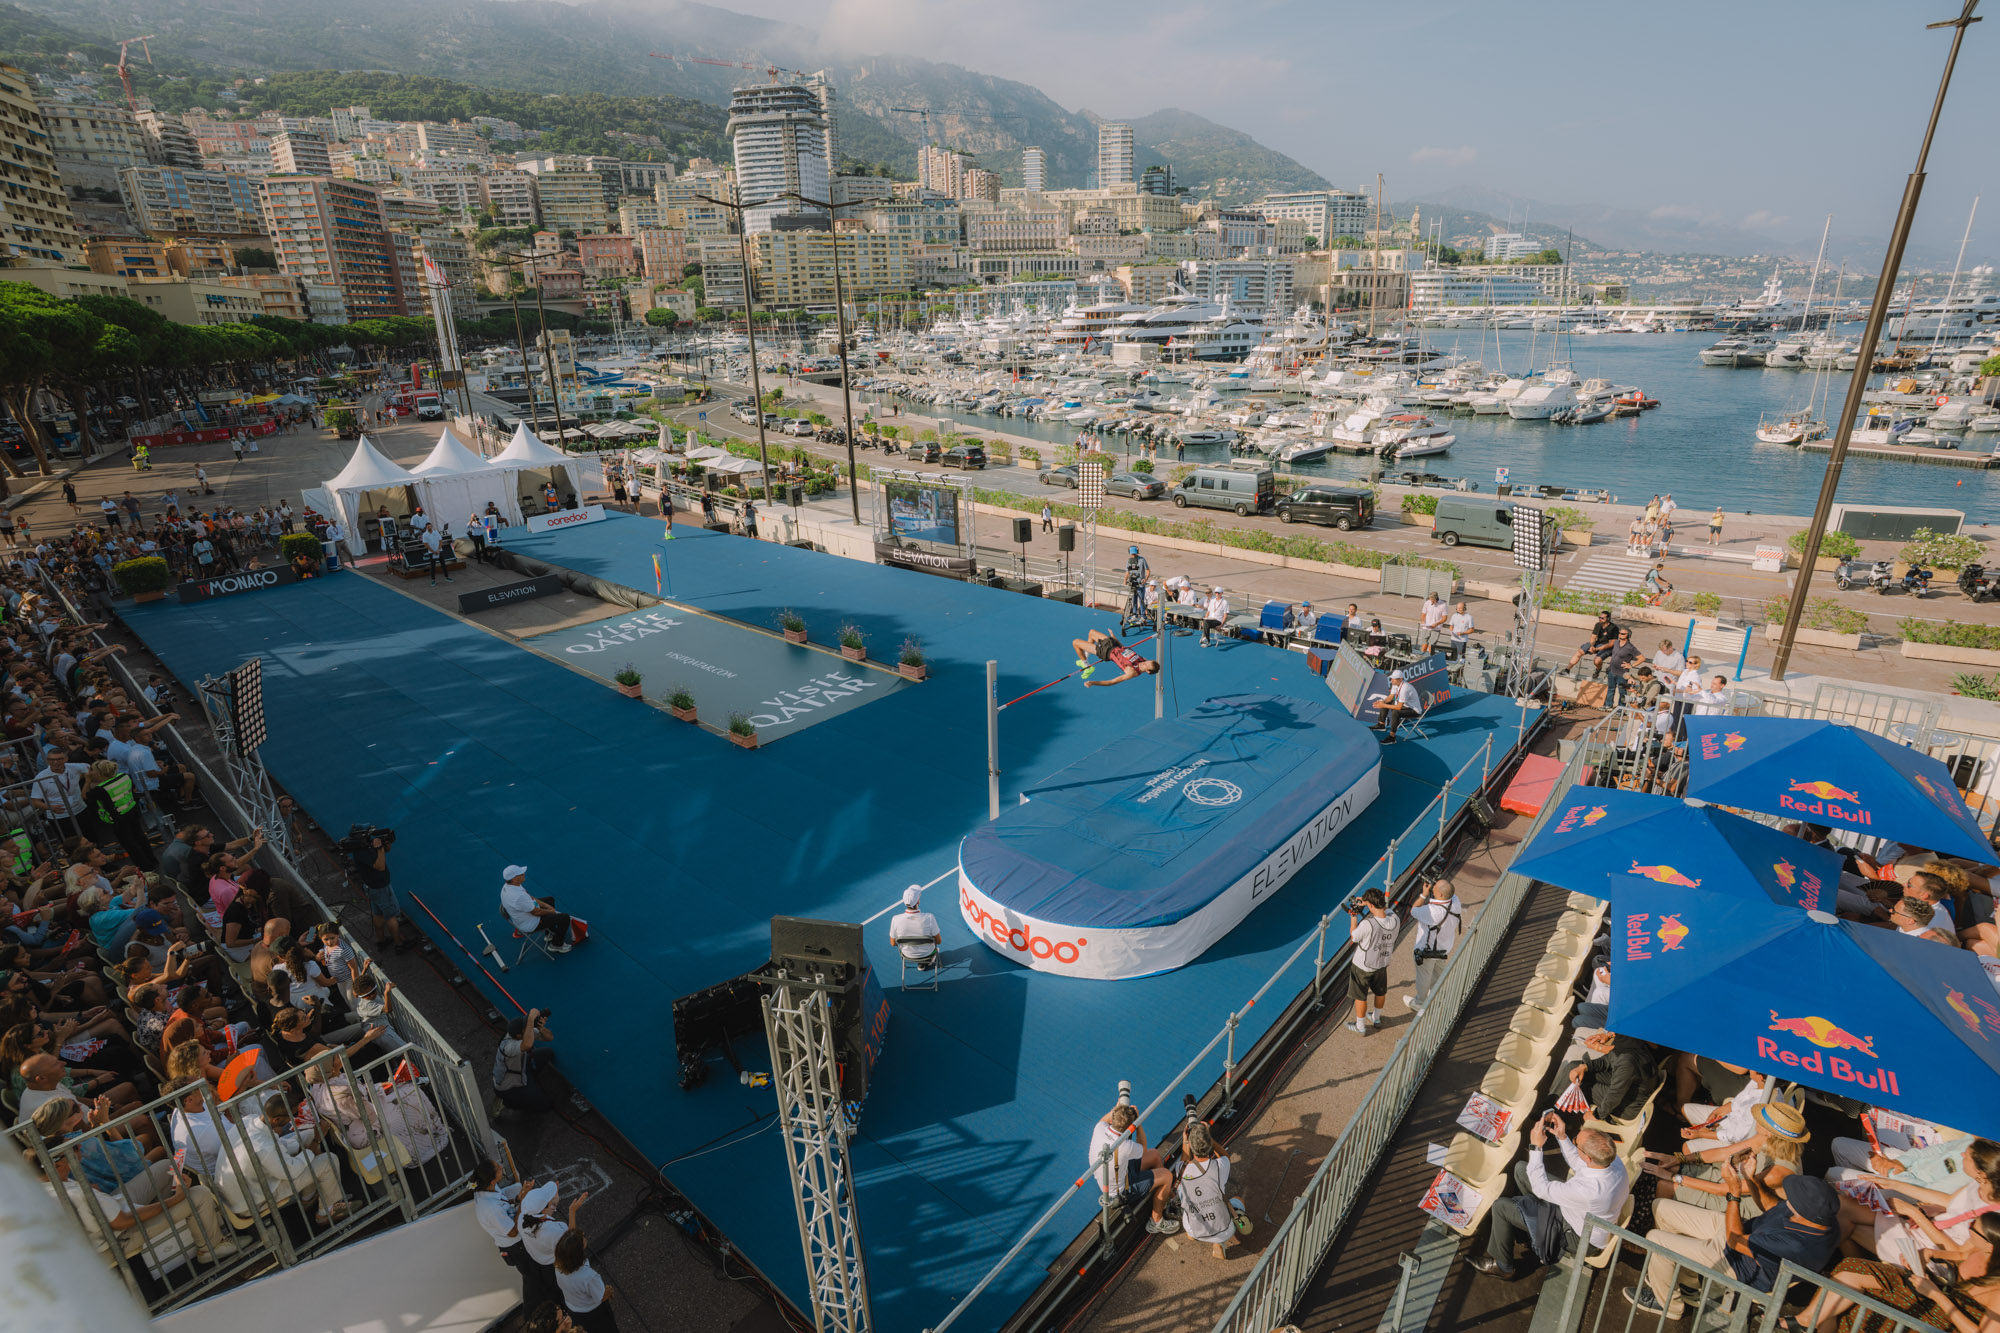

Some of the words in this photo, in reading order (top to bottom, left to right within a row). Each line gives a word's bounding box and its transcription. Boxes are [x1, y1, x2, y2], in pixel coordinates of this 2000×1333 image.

[547, 511, 588, 527] ooredoo
[892, 548, 949, 569] ELEVATION
[487, 585, 536, 603] ELEVATION
[565, 618, 683, 654] QATAR
[584, 612, 666, 640] visit
[1428, 659, 1435, 671] C
[761, 671, 852, 707] visit
[746, 678, 878, 728] QATAR
[1701, 733, 1719, 747] Red
[1702, 746, 1721, 760] Bull
[1173, 758, 1211, 780] Monaco
[1136, 778, 1179, 804] Athletics
[1563, 805, 1586, 820] Red
[1780, 794, 1824, 816] Red
[1828, 803, 1872, 826] Bull
[1553, 819, 1578, 834] Bull
[1251, 794, 1354, 900] ELEVATION
[1801, 869, 1822, 896] Bull
[1798, 886, 1819, 911] Red
[962, 887, 1085, 964] ooredoo
[1627, 913, 1651, 937] Red
[1627, 936, 1652, 961] Bull
[1756, 1035, 1824, 1075] Red
[1829, 1055, 1900, 1096] Bull
[1194, 1187, 1202, 1197] 6
[1202, 1212, 1216, 1222] HB
